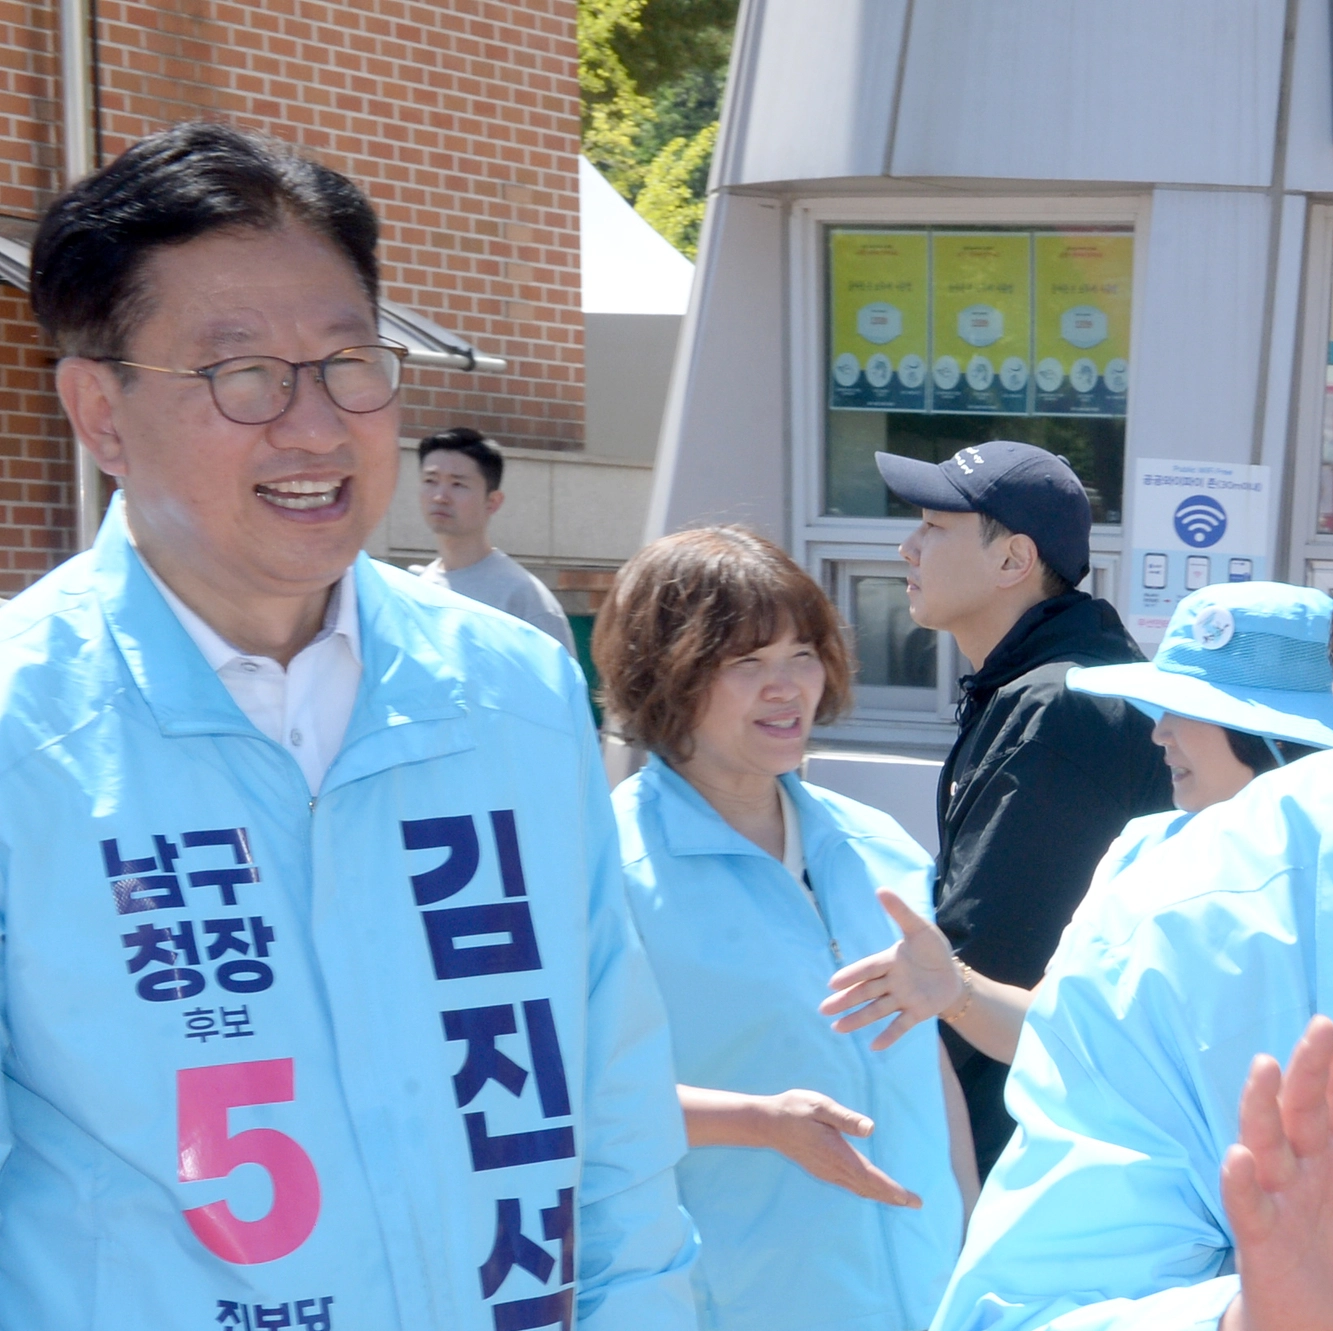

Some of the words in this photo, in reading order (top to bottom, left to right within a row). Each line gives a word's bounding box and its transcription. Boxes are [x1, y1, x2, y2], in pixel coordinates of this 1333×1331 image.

[1143, 474, 1204, 487] 공공와이파이
[102, 827, 262, 915] 남구
[121, 916, 275, 1003] 청장
[183, 1004, 256, 1044] 후보
[176, 1057, 321, 1266] 5
